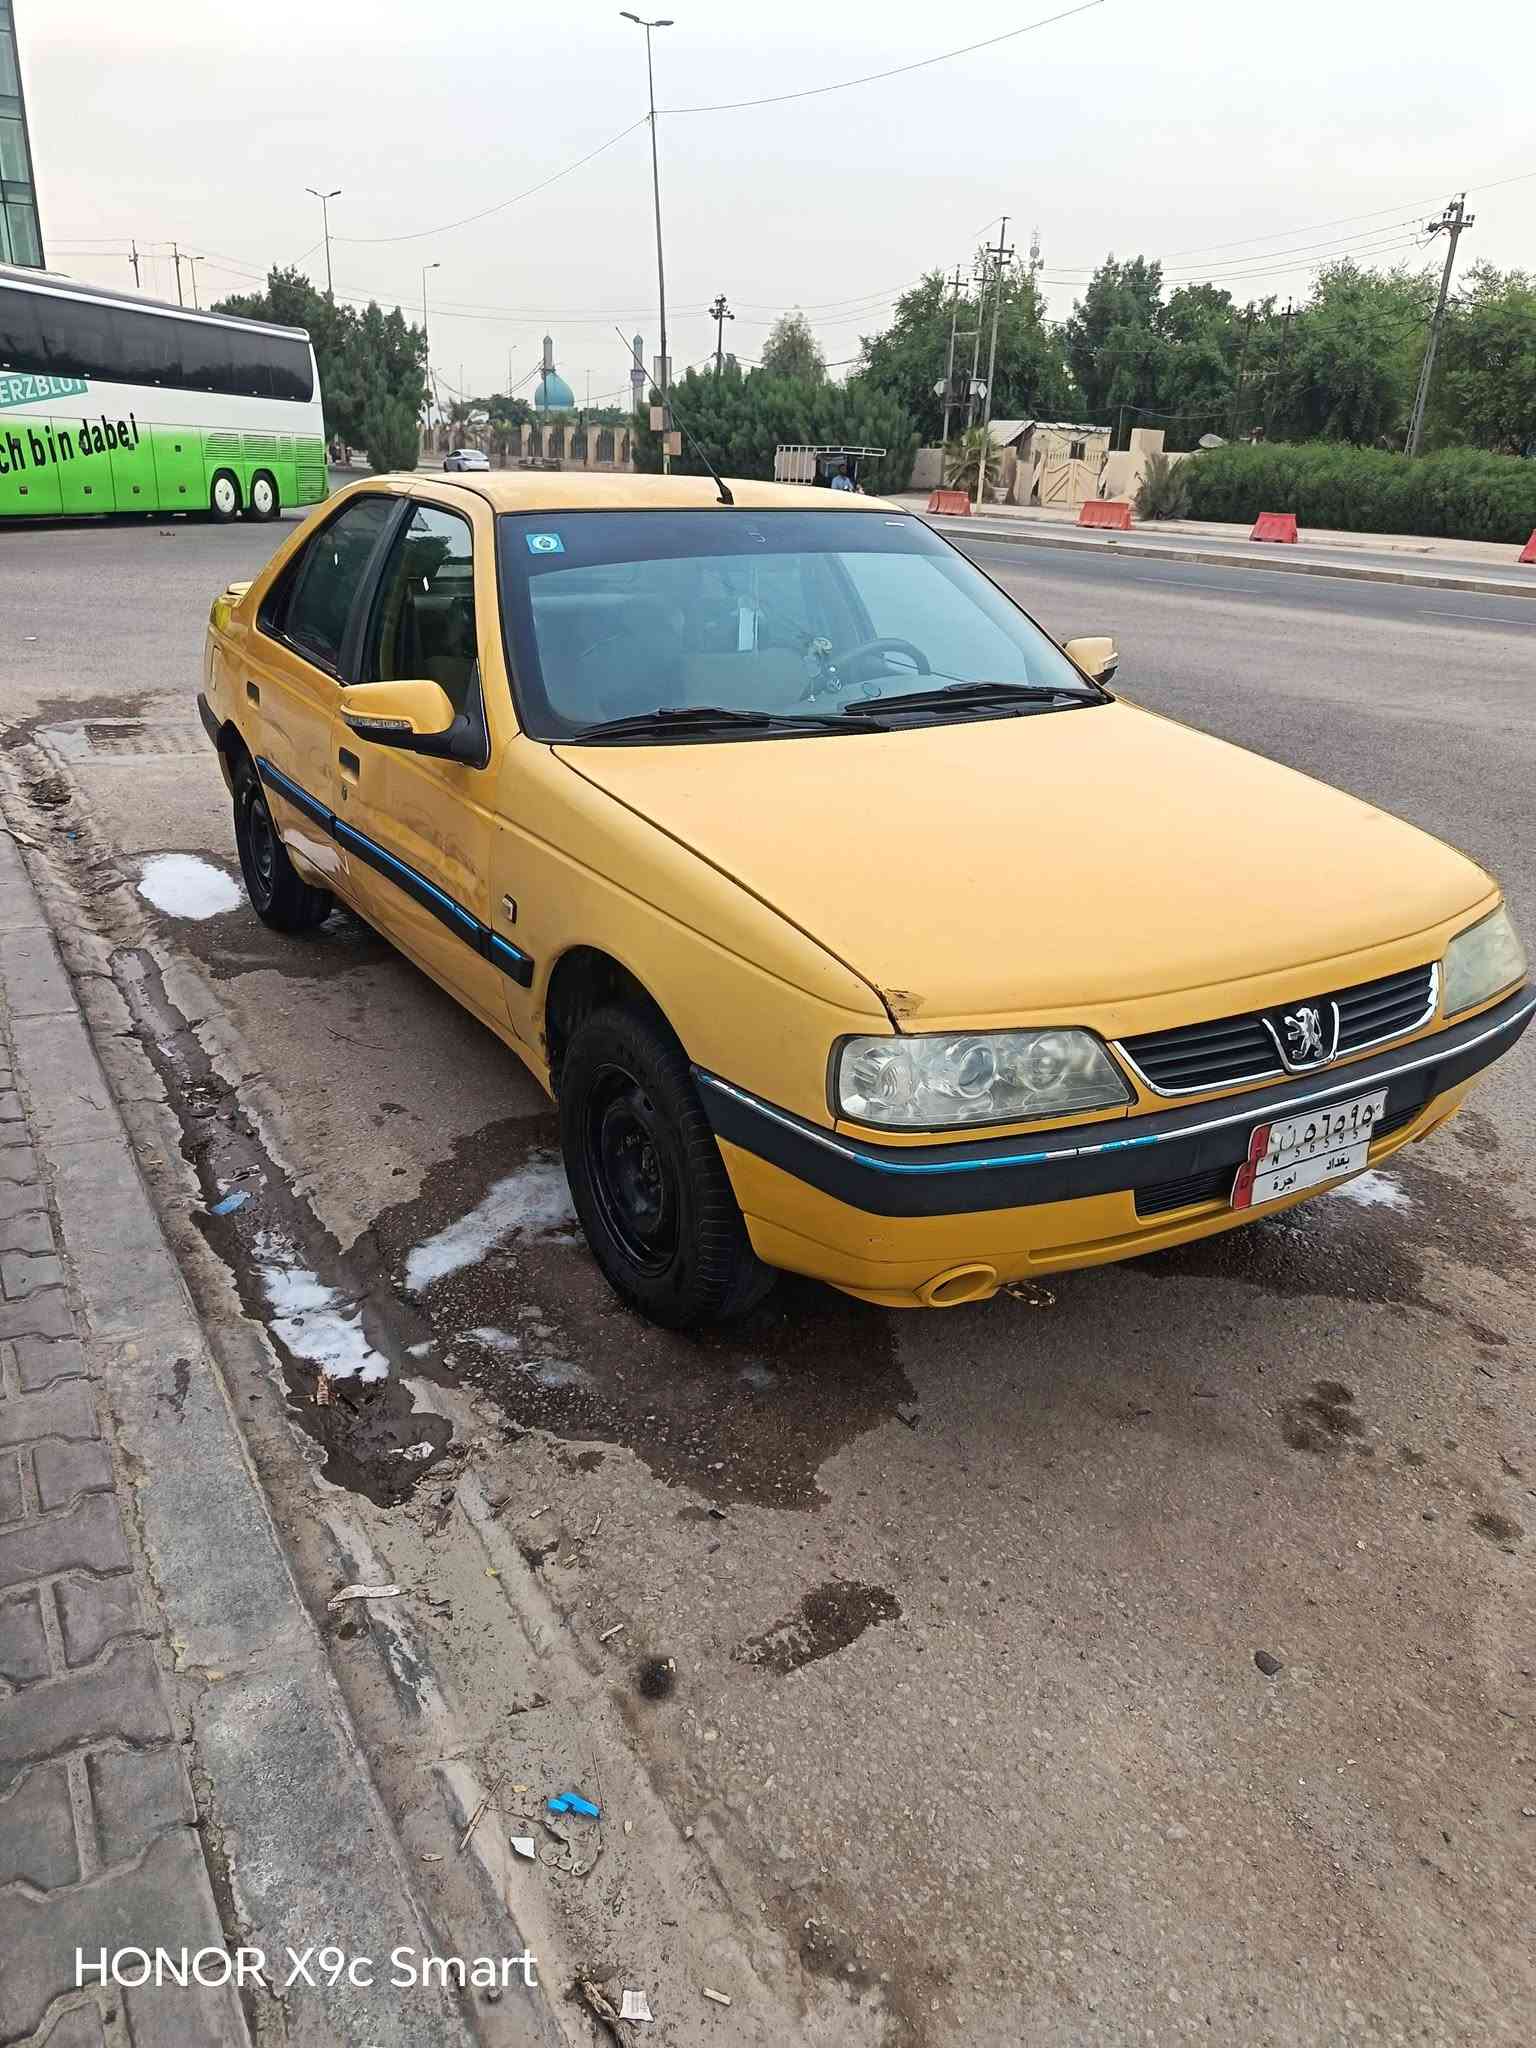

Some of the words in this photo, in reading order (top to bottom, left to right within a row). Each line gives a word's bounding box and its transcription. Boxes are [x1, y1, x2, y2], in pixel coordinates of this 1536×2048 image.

[27, 425, 75, 467] bin
[78, 412, 140, 456] dabei
[1326, 1151, 1351, 1171] بغداد
